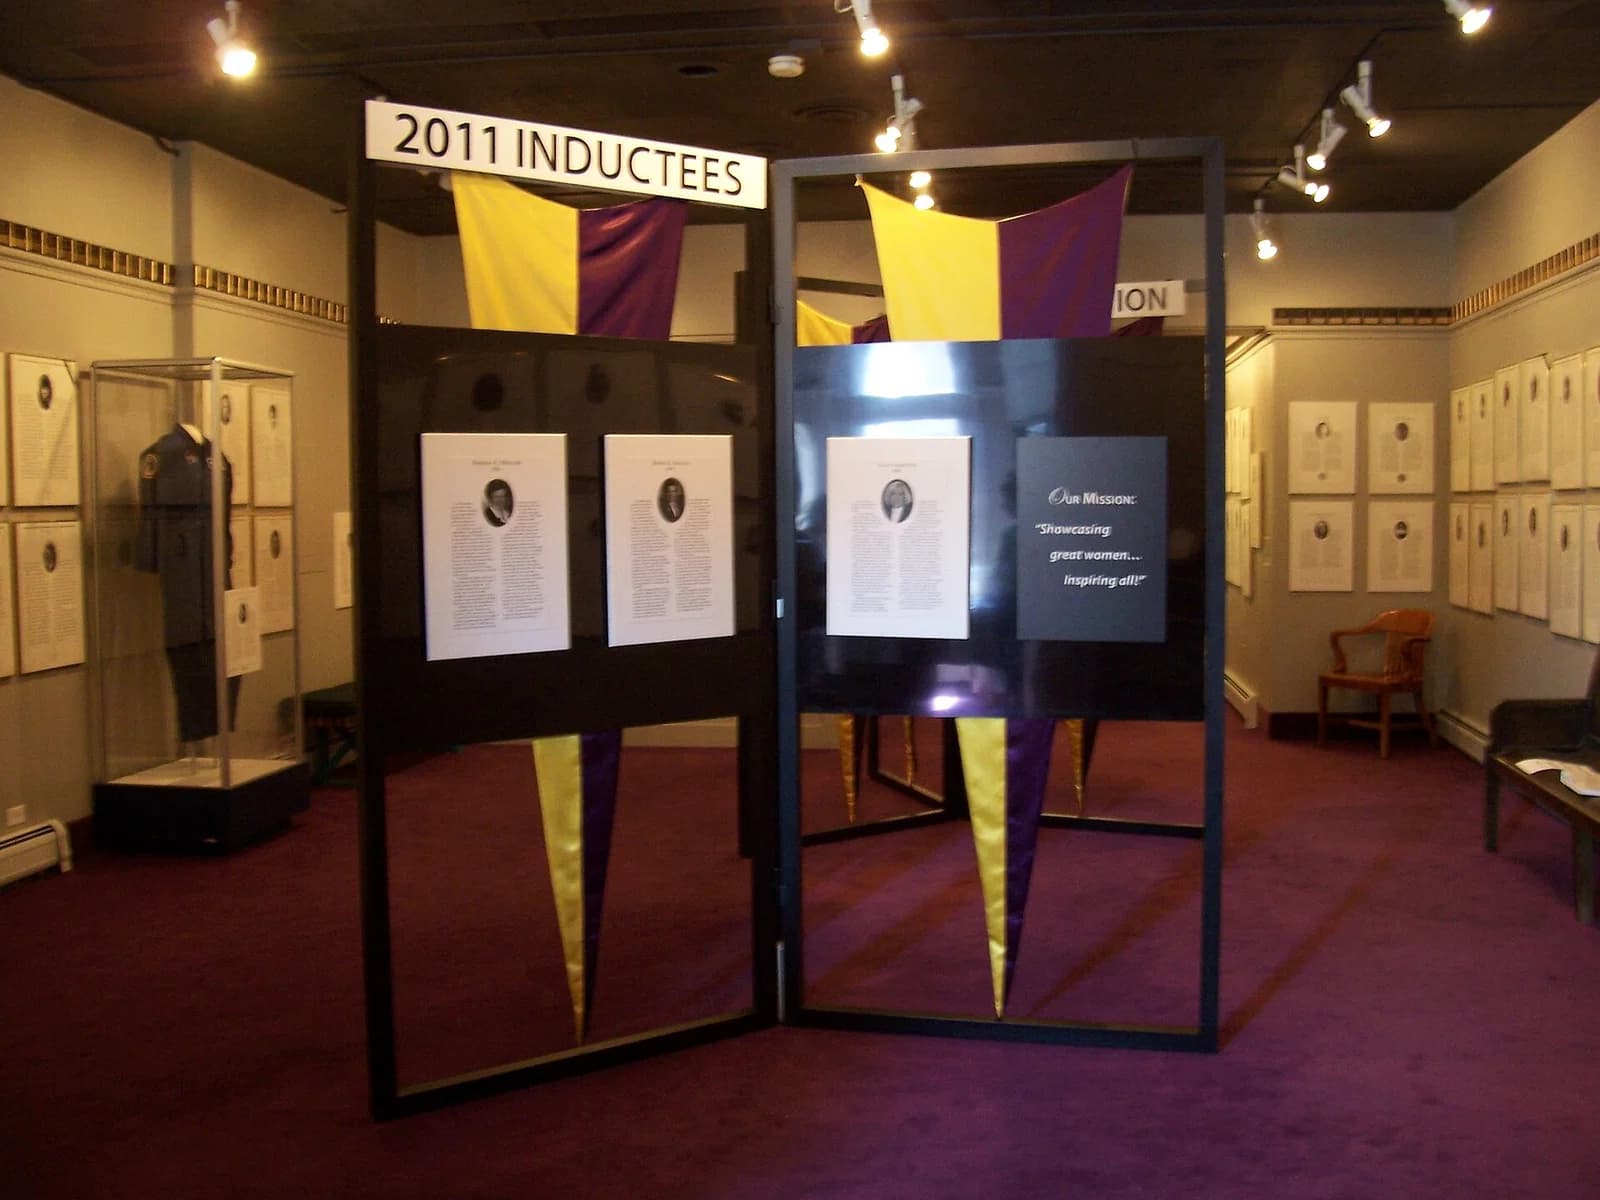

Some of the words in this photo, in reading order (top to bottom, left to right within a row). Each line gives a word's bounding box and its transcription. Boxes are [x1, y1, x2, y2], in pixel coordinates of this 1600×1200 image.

[395, 113, 497, 164] 2011
[516, 128, 743, 196] INDUCTEES
[1049, 550, 1081, 562] great
[1063, 574, 1117, 588] inspiring
